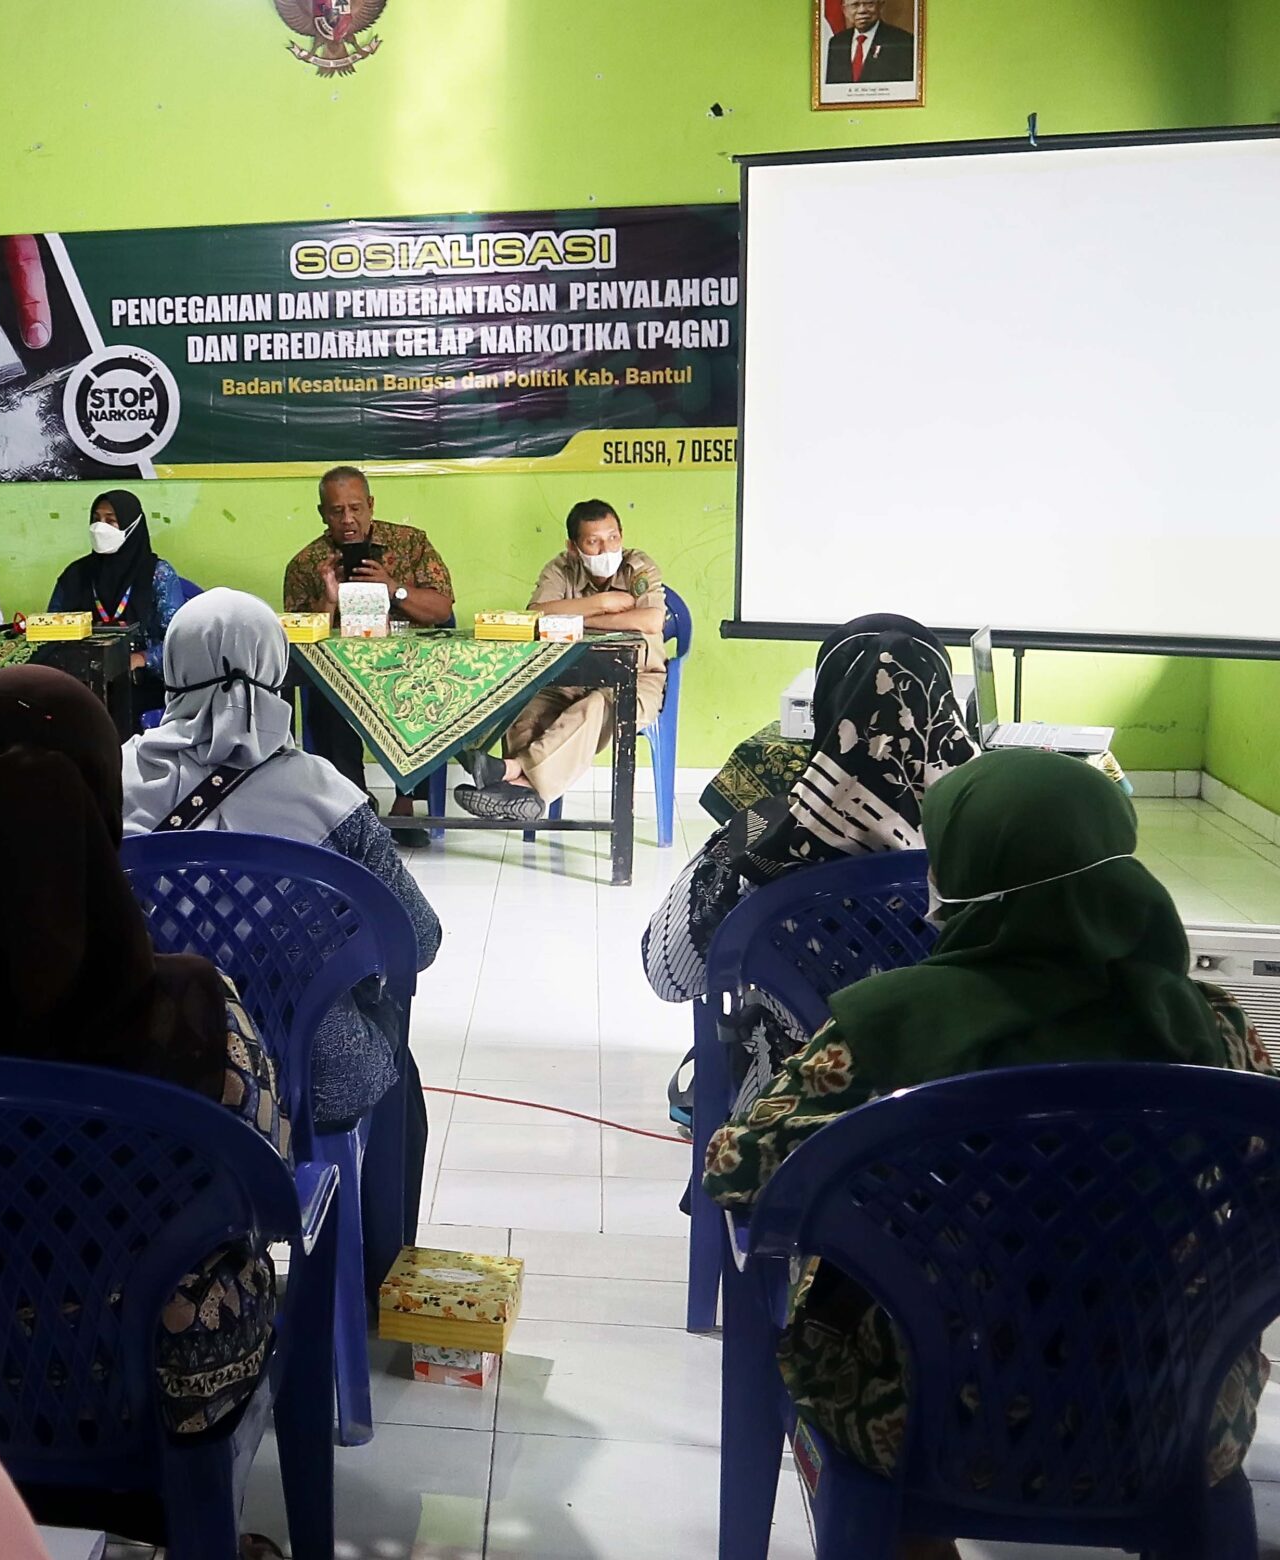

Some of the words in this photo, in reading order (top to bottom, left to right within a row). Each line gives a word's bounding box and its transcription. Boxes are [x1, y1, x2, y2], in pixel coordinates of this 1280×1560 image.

[294, 233, 612, 273] SOSIALISASI
[111, 294, 273, 327] PENCEGAHAN
[278, 292, 331, 321] DAN
[335, 282, 557, 319] PEMBERANTASAN
[569, 277, 738, 311] PENYALAHGU
[187, 334, 238, 363] DAN
[243, 329, 390, 361] PEREDARAN
[395, 326, 475, 357] GELAP
[480, 322, 631, 354] NARKOTIKA
[636, 319, 730, 350] (P4GN)
[222, 376, 282, 396] Badan
[288, 374, 378, 394] Kesatuan
[383, 372, 455, 393] Bangsa
[461, 371, 499, 389] dan
[504, 368, 569, 388] Politik
[574, 368, 620, 386] Kab.
[625, 366, 692, 385] Bantul
[90, 387, 155, 408] STOP
[89, 409, 157, 421] NARKOBA
[603, 440, 671, 466] SELASA,
[677, 440, 686, 463] 7
[692, 439, 737, 462] DESE
